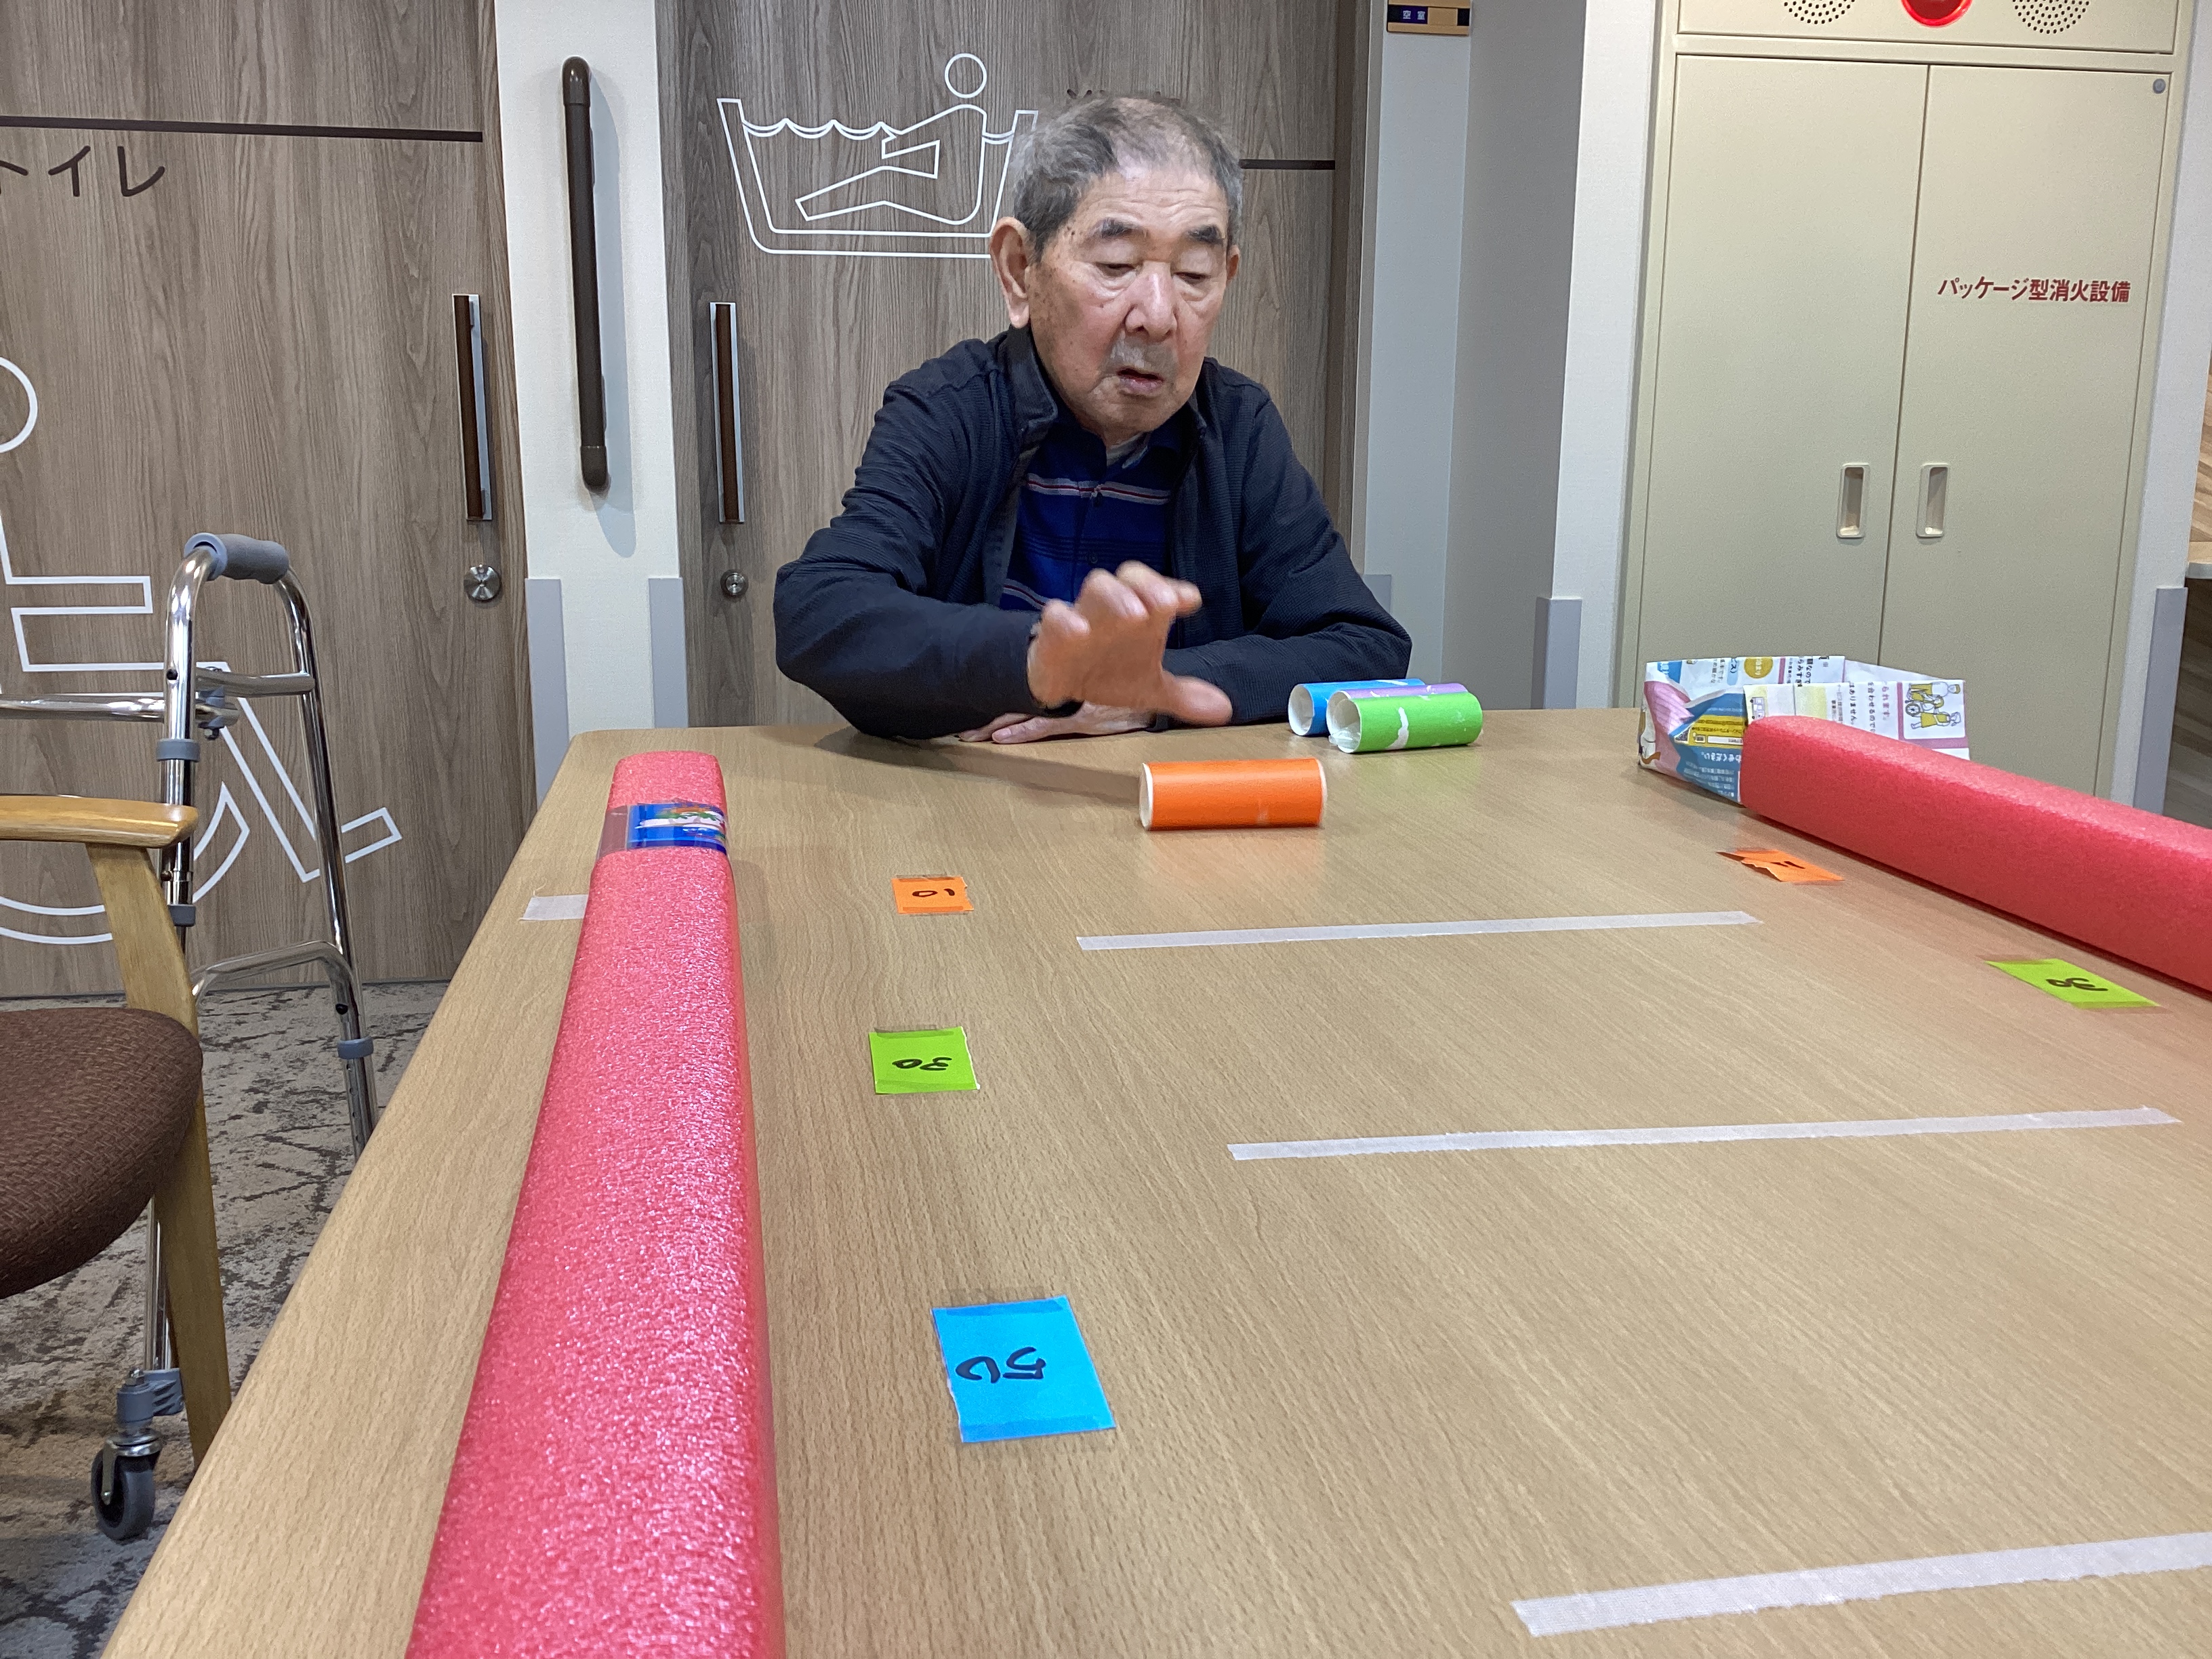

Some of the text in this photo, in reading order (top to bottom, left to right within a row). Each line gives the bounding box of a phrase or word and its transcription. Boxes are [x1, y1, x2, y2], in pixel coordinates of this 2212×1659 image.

[1937, 276, 2131, 303] パッケージ型消火設備
[1881, 682, 1890, 721] られます。
[891, 1057, 953, 1071] 30
[955, 1346, 1046, 1384] 50
